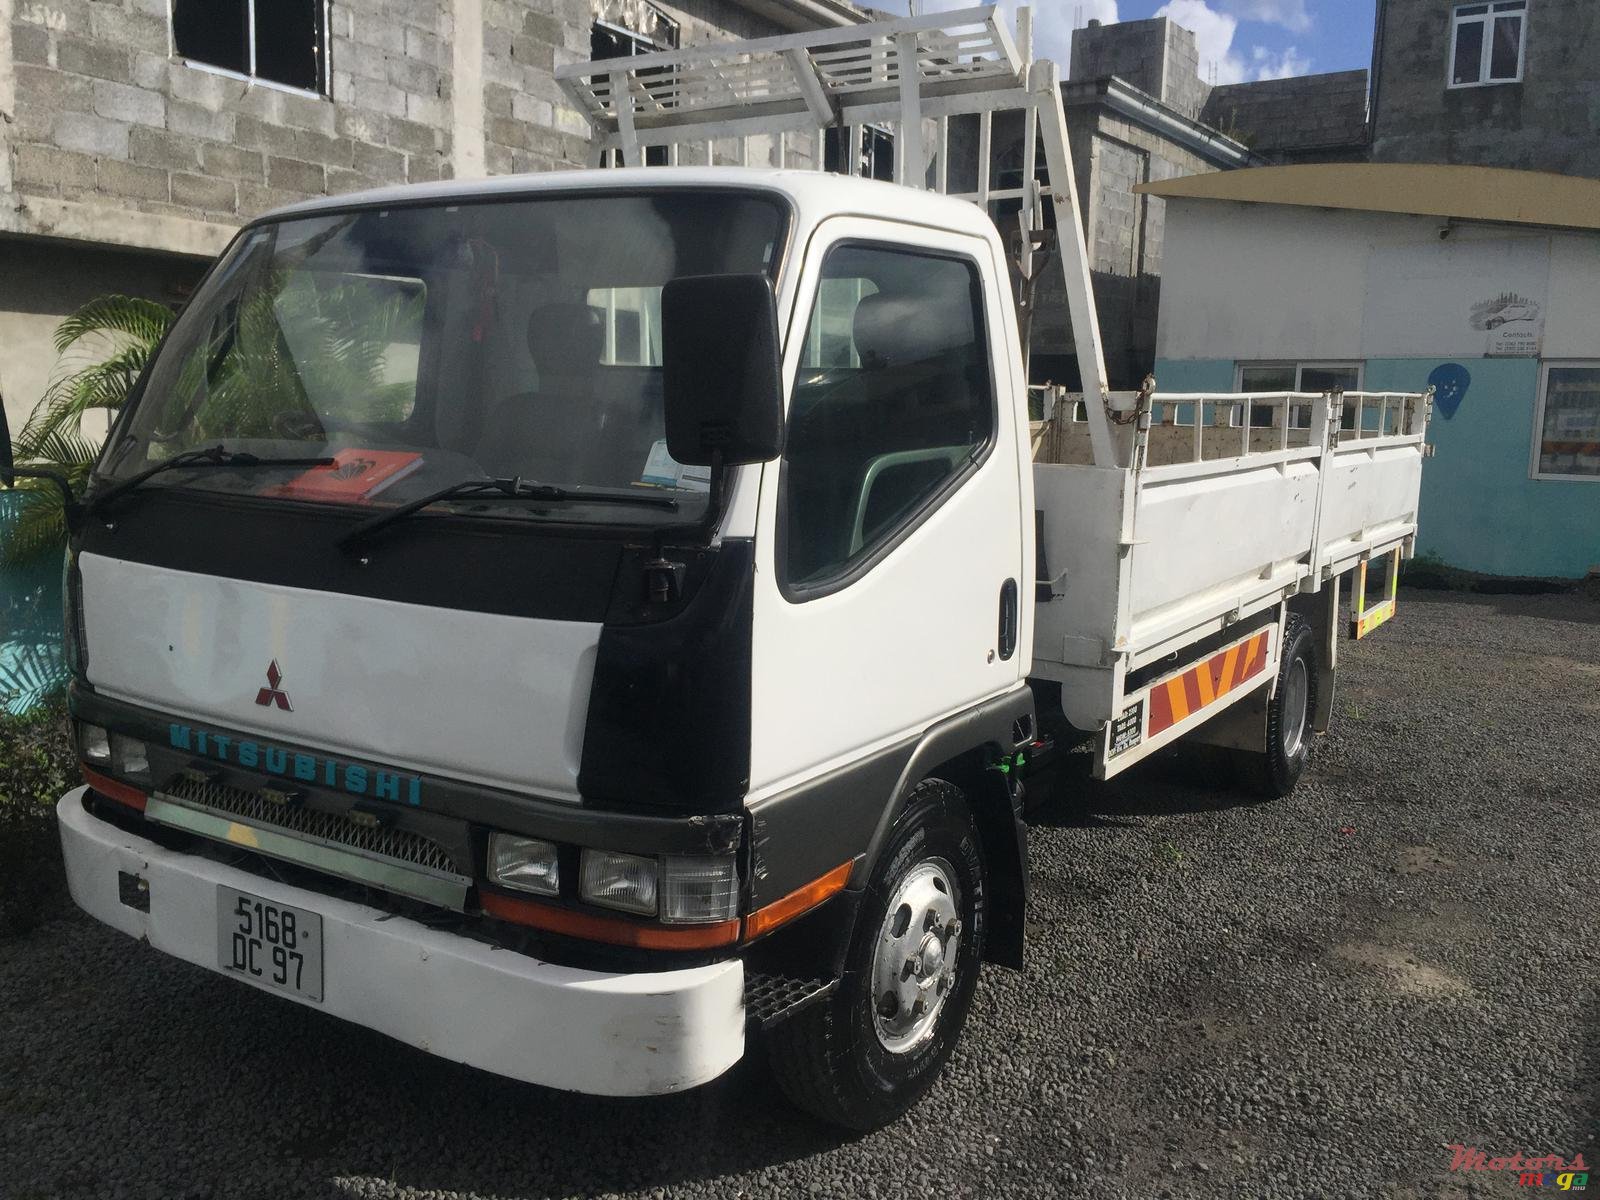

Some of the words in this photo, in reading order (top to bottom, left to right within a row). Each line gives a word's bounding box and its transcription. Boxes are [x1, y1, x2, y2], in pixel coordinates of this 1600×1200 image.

[169, 724, 422, 806] MITSUBISHI
[235, 896, 297, 950] 5168
[232, 932, 263, 977] DC
[272, 946, 304, 990] 97
